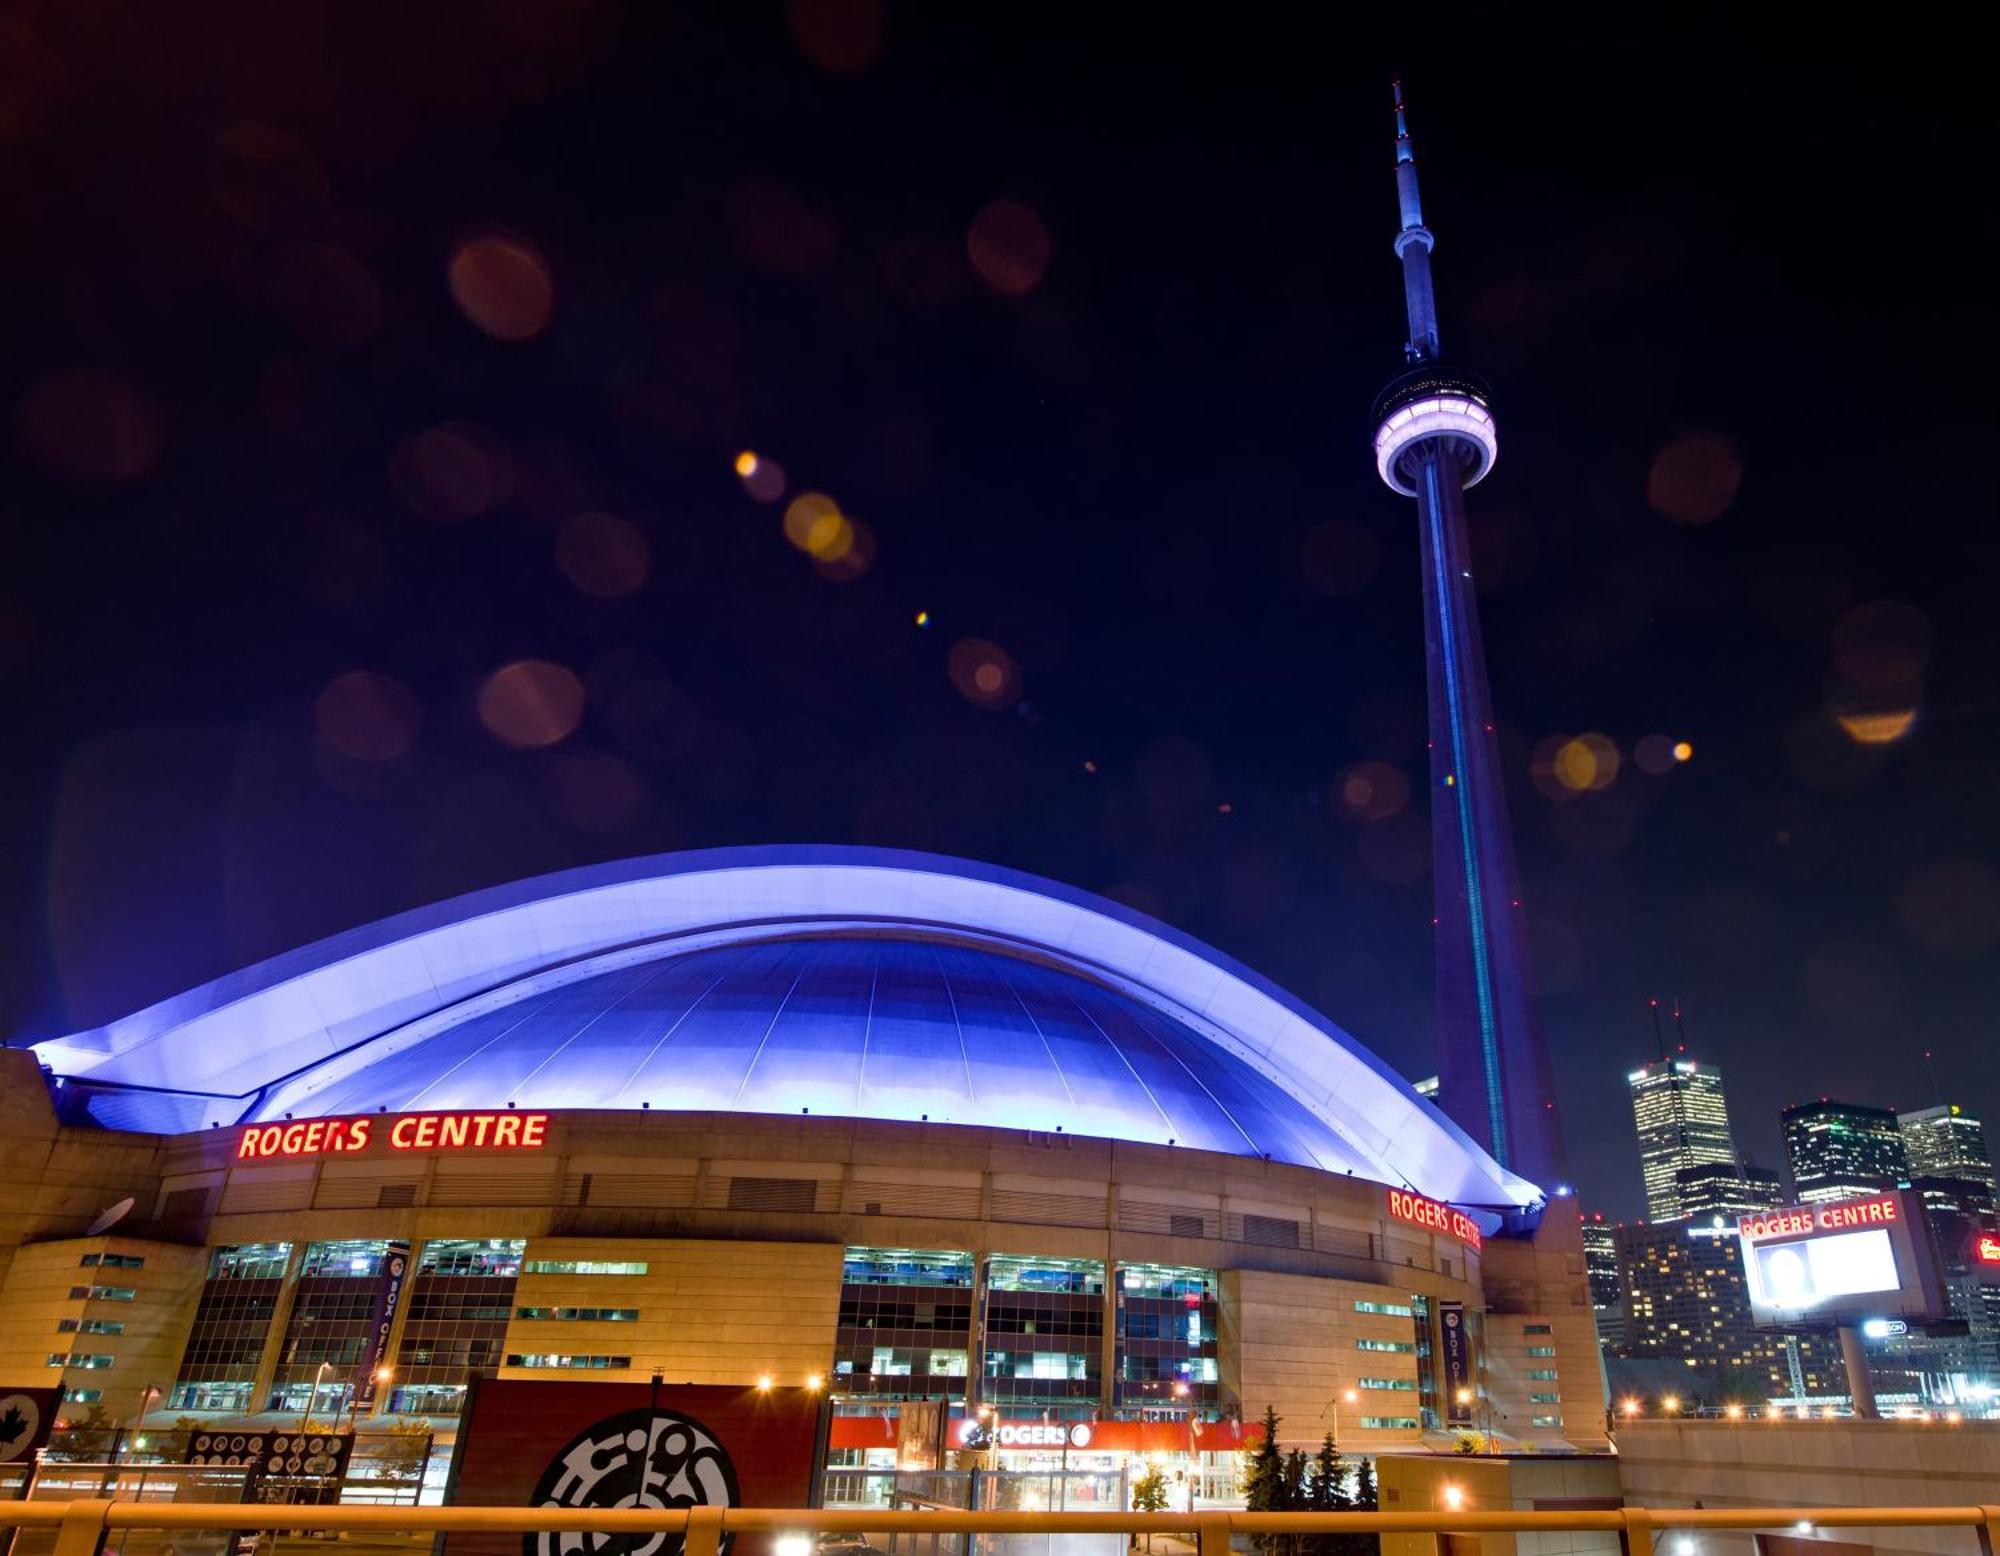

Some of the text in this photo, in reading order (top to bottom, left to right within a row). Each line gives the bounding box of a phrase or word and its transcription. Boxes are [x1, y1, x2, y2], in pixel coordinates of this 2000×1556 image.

[238, 1115, 548, 1158] ROGERS CENTRE
[1390, 1191, 1449, 1231] ROGERS
[1741, 1201, 1896, 1239] ROGERS CENTRE
[384, 1280, 399, 1317] BOX
